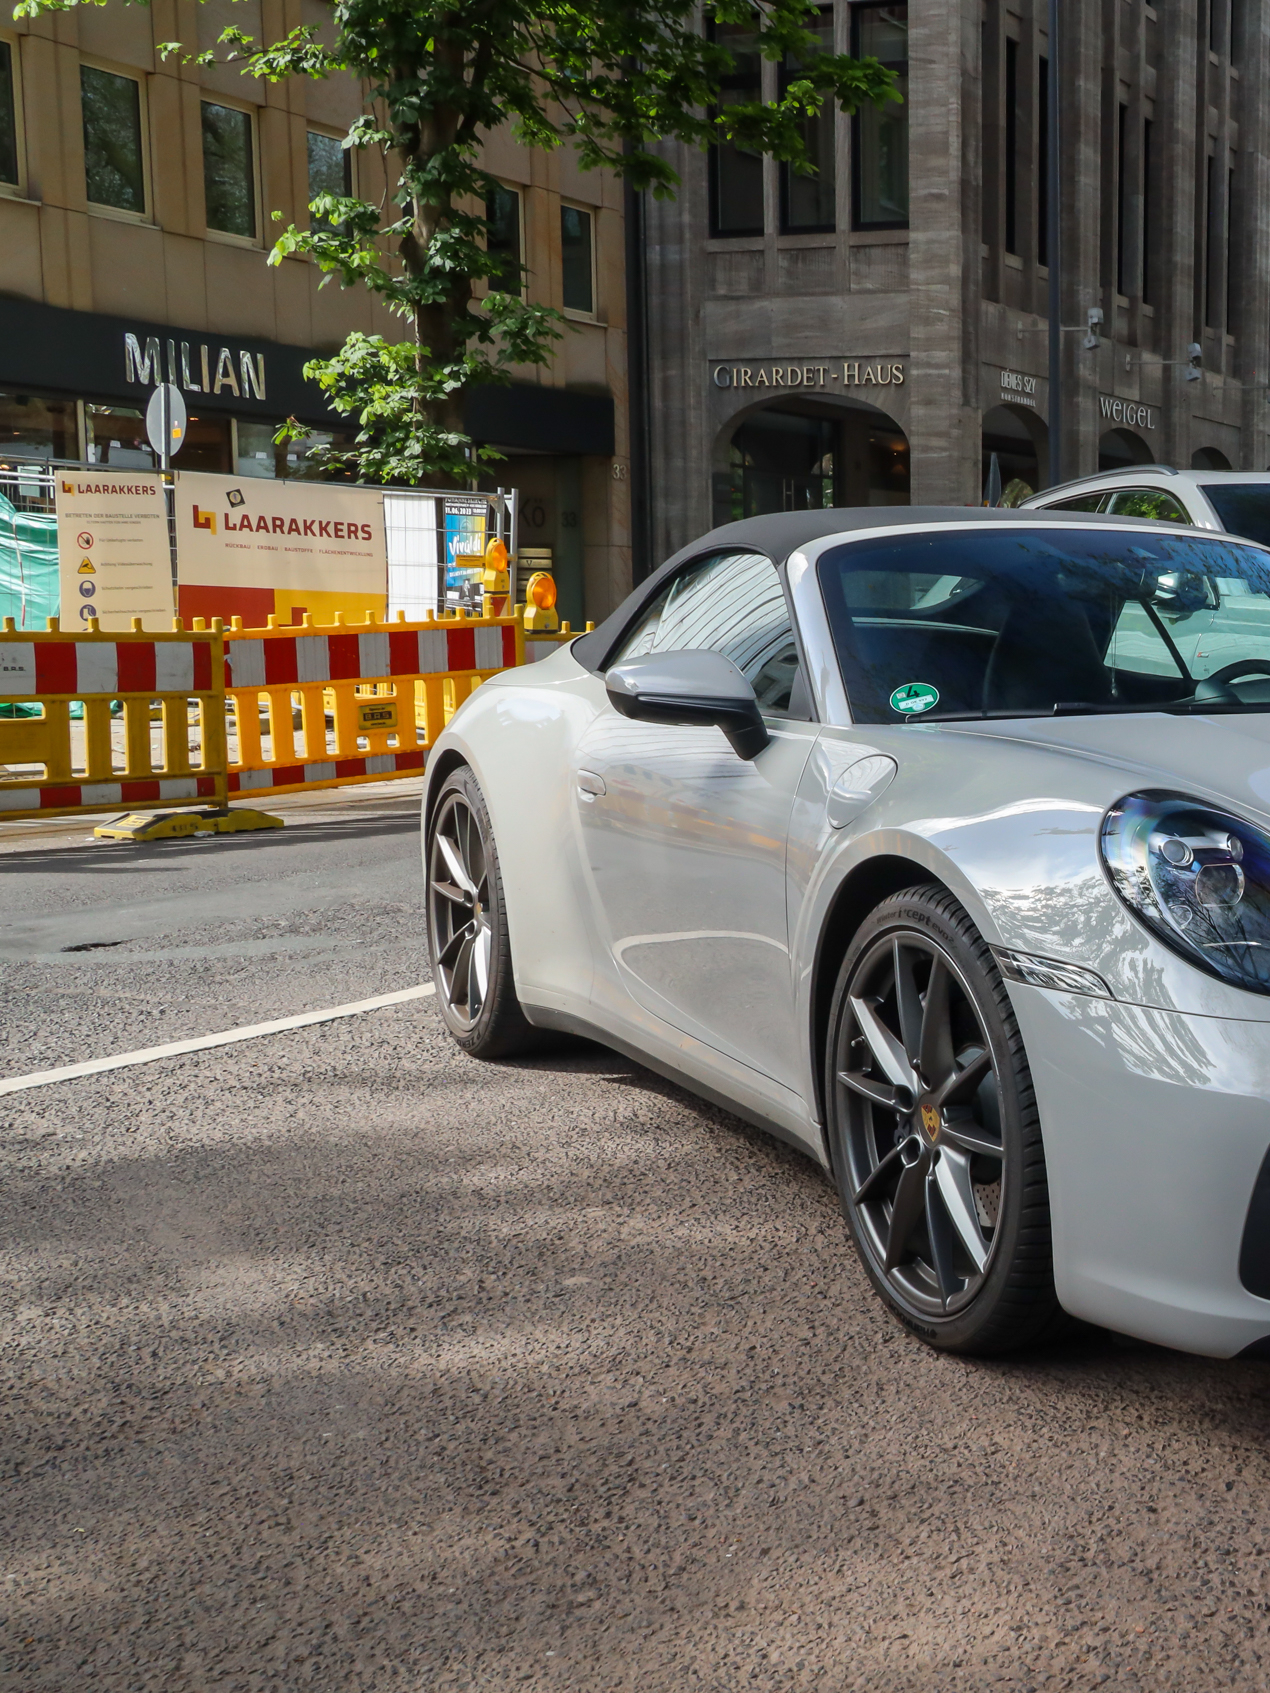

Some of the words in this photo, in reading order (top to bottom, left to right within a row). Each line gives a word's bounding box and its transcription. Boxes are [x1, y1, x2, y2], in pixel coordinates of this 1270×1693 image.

[125, 333, 266, 401] MILIAN
[1023, 376, 1036, 394] SZY
[612, 464, 627, 479] 33
[78, 483, 156, 495] LAARAKKERS
[224, 512, 373, 541] LAARAKKERS
[906, 685, 920, 697] 4
